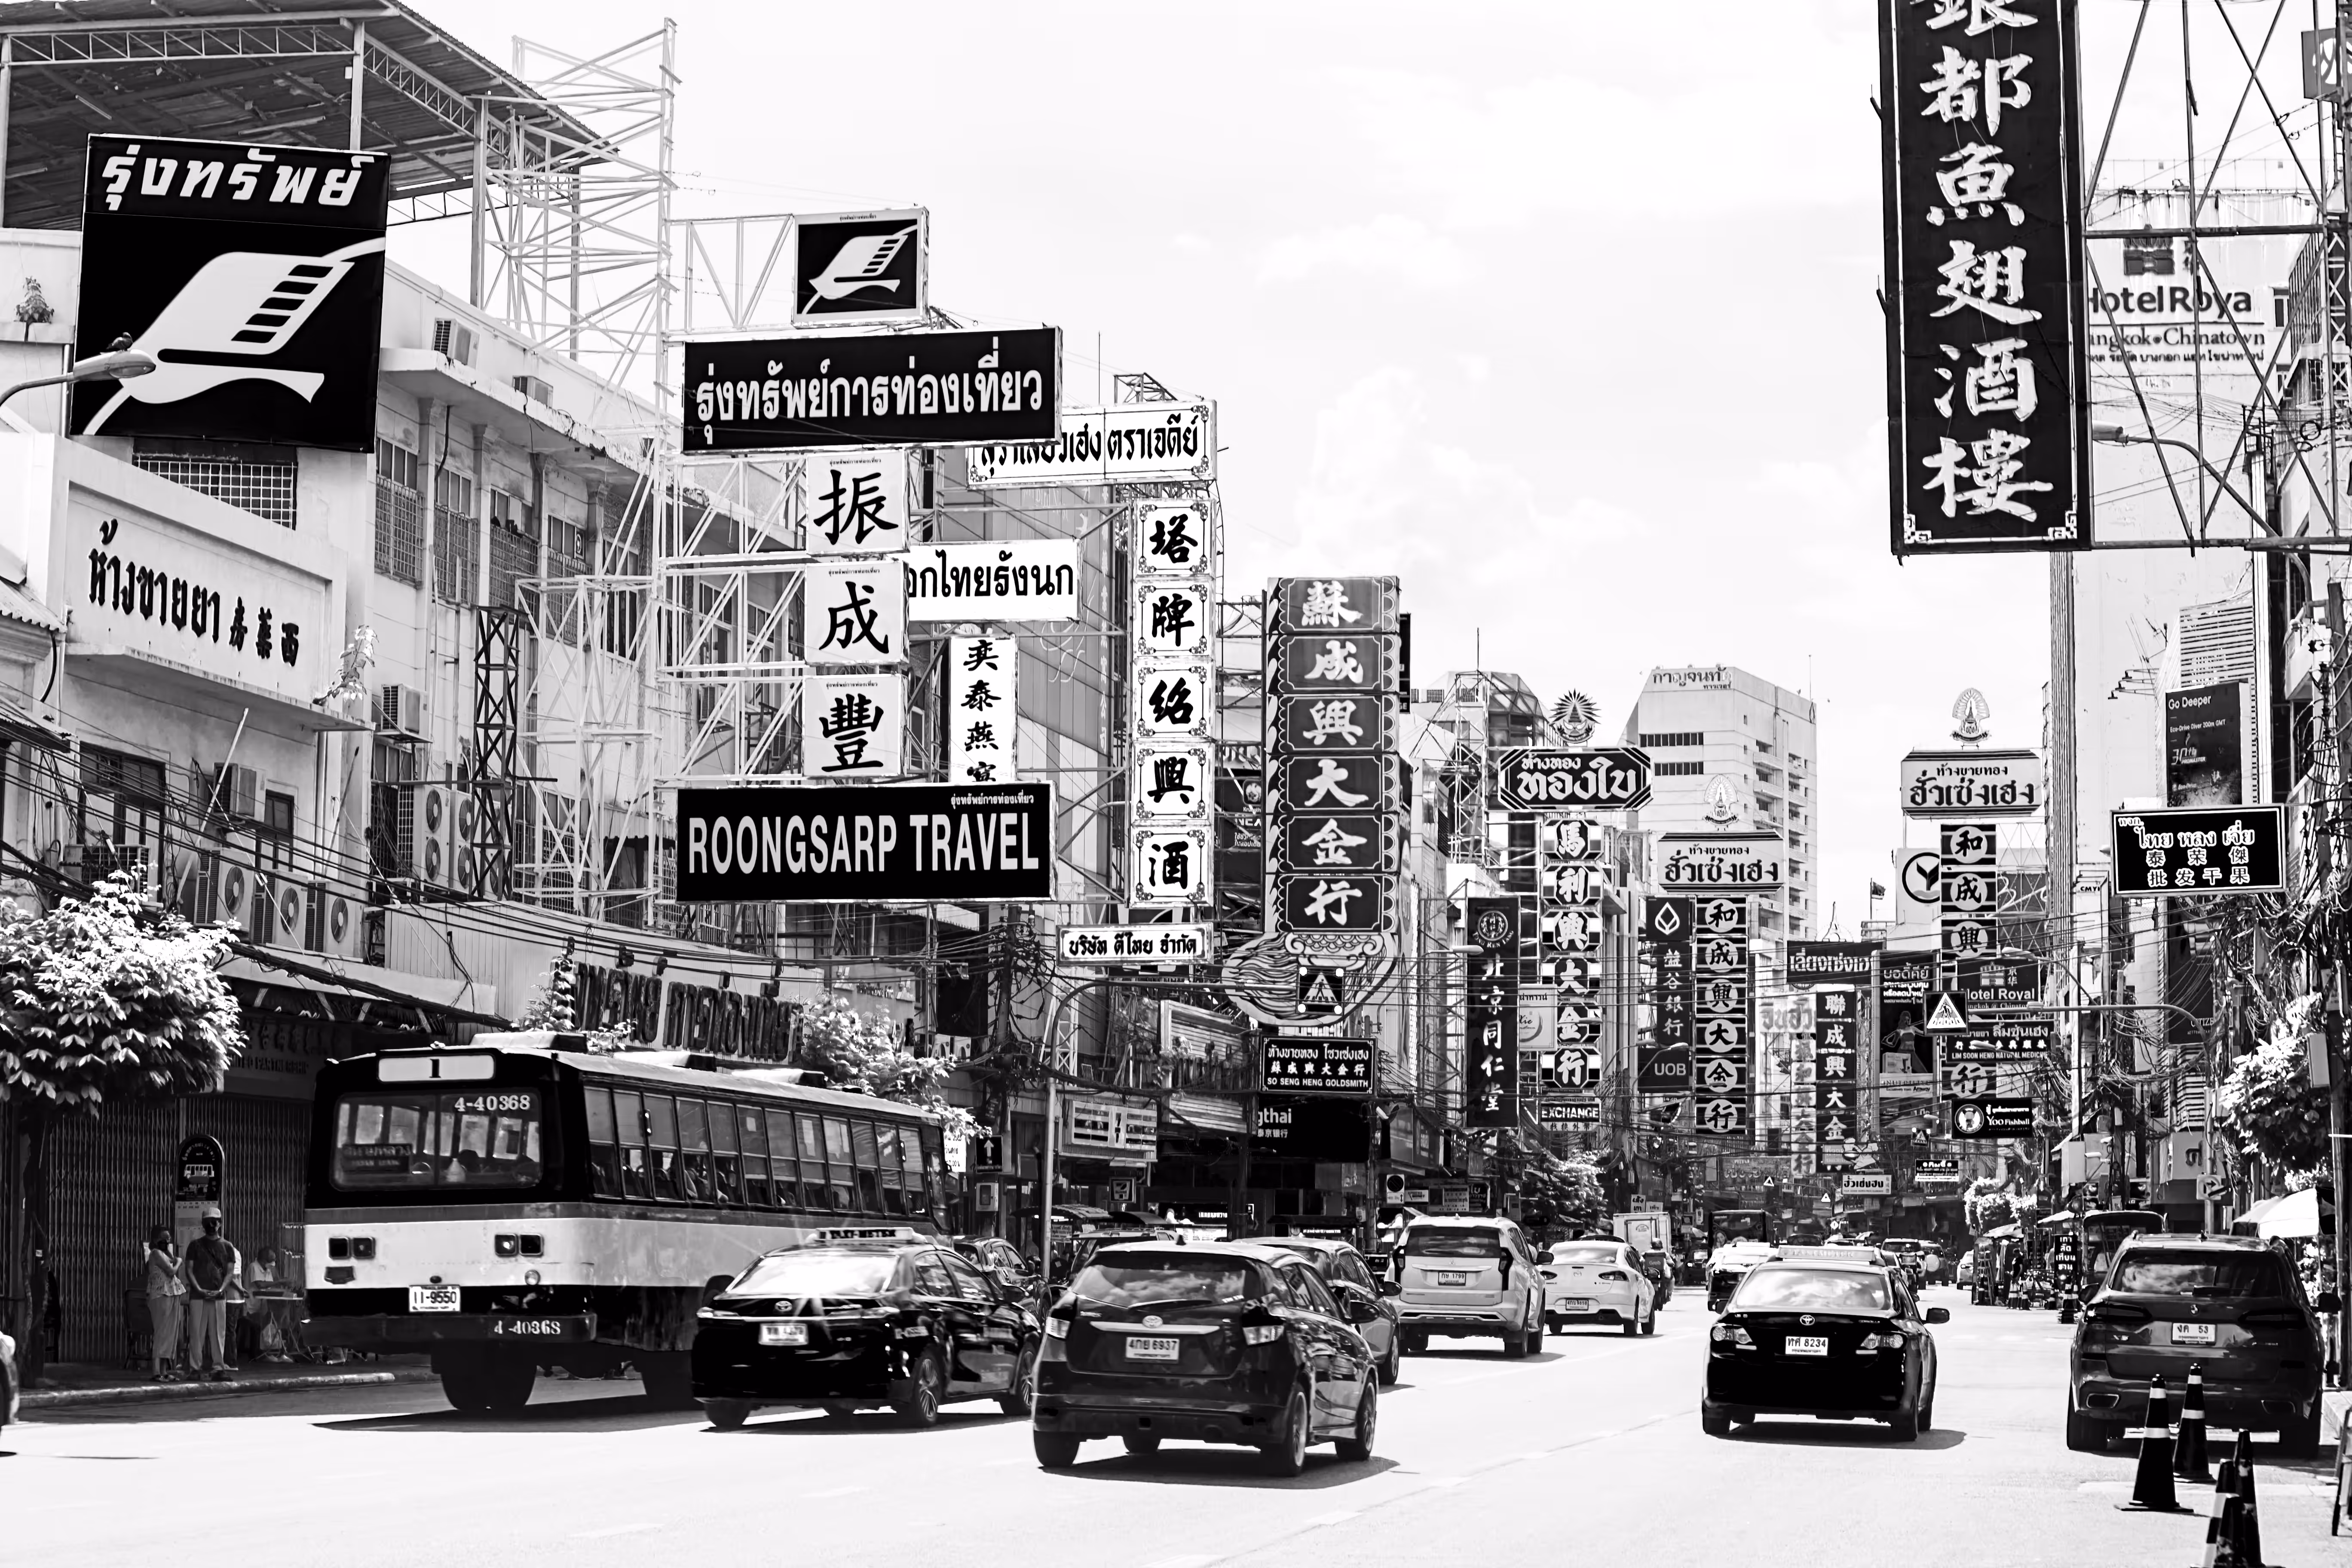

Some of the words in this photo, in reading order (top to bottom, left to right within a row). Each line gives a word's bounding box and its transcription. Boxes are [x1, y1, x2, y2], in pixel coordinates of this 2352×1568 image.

[102, 144, 374, 211] รุ่งทรัพย์
[696, 336, 1042, 445] รุ่งทรัพย์การท่องเที่ยว
[88, 518, 220, 643] ห้างขายยา
[2168, 698, 2180, 710] Go
[2182, 695, 2211, 708] Deeper
[1522, 753, 1581, 770] ห้างทอง
[1937, 763, 2008, 777] ห้างขายทอง
[1517, 756, 1637, 800] ทองใบ
[689, 815, 897, 875] ROONGSARP
[910, 812, 1039, 872] TRAVEL
[2134, 826, 2174, 848] ไทย
[2177, 831, 2216, 848] หลง
[1689, 843, 1749, 855] ห้างขายทอง
[2147, 866, 2250, 888] 批发干果
[1999, 988, 2035, 1001] Royal
[1481, 954, 1504, 1112] 北京同仁堂
[1655, 1063, 1686, 1075] UOB
[1267, 1077, 1277, 1086] SO
[1280, 1077, 1299, 1086] SENG
[1302, 1078, 1323, 1087] HENG
[1325, 1078, 1369, 1088] GOLDSMITH
[1825, 994, 1847, 1170] 聯成興大金
[454, 1095, 531, 1112] 4-40368
[1542, 1107, 1599, 1118] EXCHANGE
[413, 1290, 457, 1305] 11-9550
[1152, 1340, 1177, 1351] 6937
[1804, 1338, 1826, 1348] 8234
